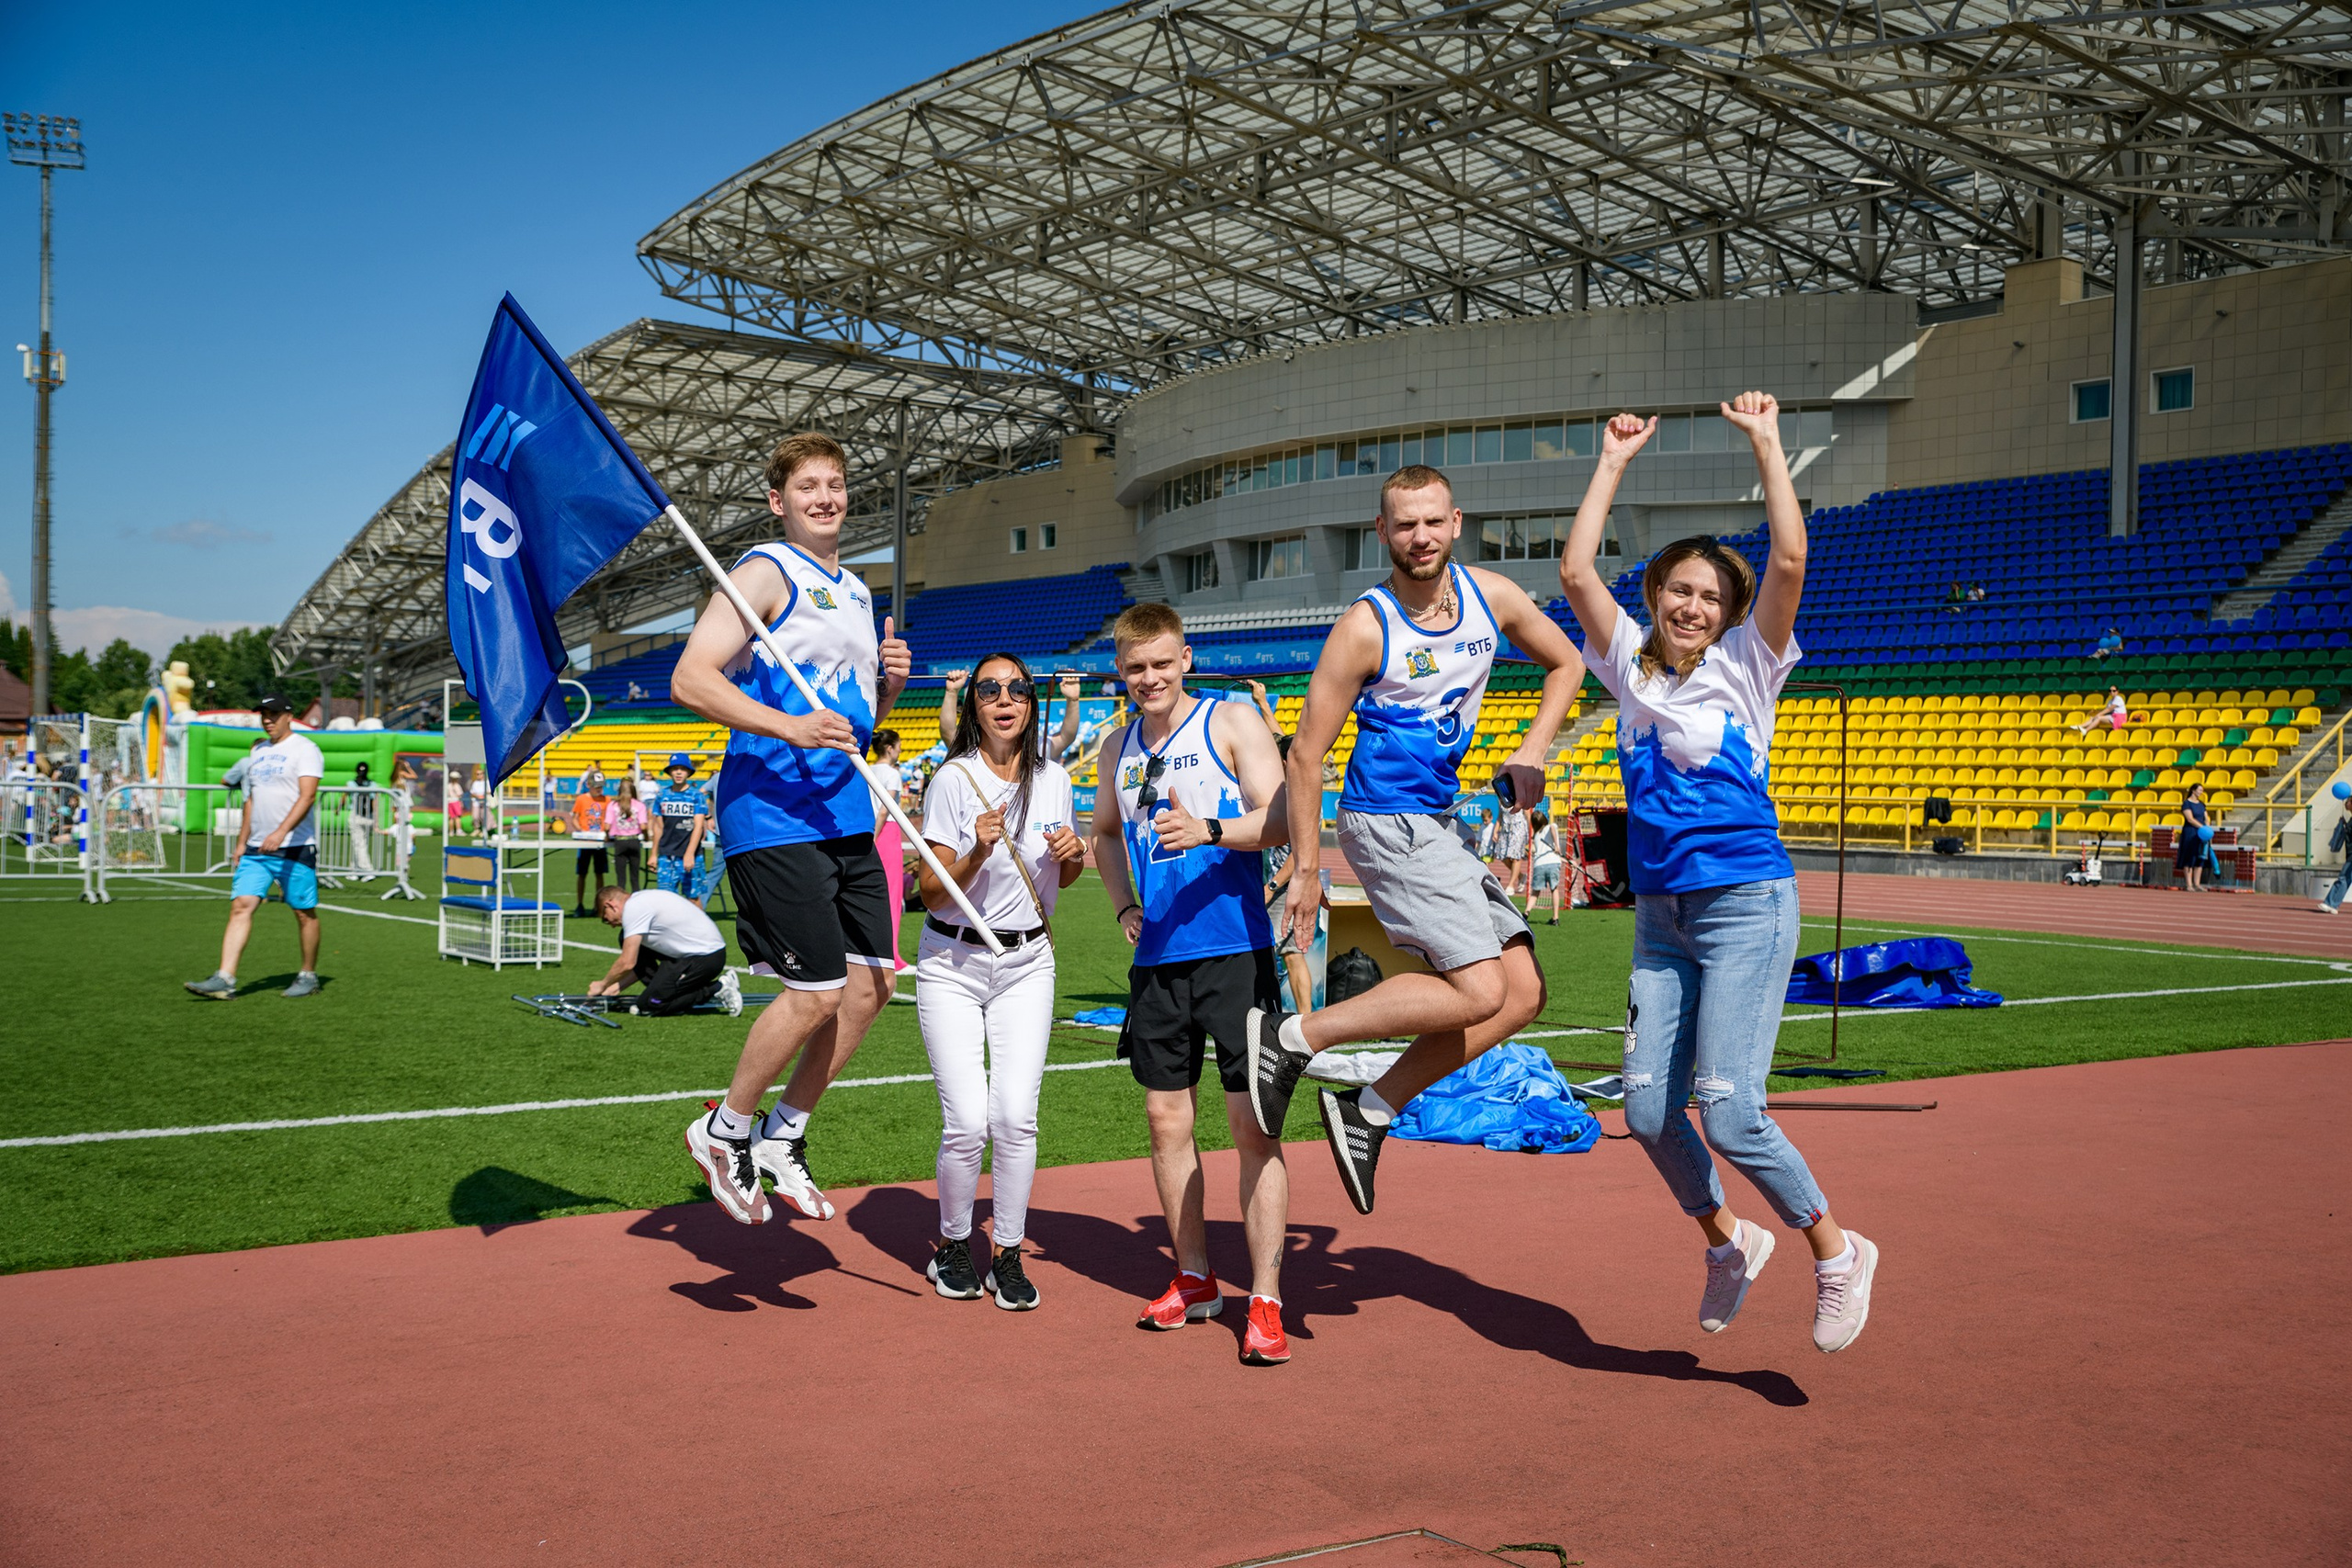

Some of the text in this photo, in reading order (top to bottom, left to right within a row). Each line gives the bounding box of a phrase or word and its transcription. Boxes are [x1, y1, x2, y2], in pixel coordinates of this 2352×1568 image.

[1467, 637, 1492, 657] ВТБ
[1198, 657, 1211, 666] ВТБ
[1230, 656, 1242, 665] ВТБ
[1261, 654, 1274, 663] ВТБ
[1296, 652, 1310, 661] ВТБ
[1436, 687, 1470, 747] 3
[1174, 753, 1198, 770] ВТБ
[1080, 794, 1094, 805] ВТБ
[1461, 804, 1482, 817] ВТБ
